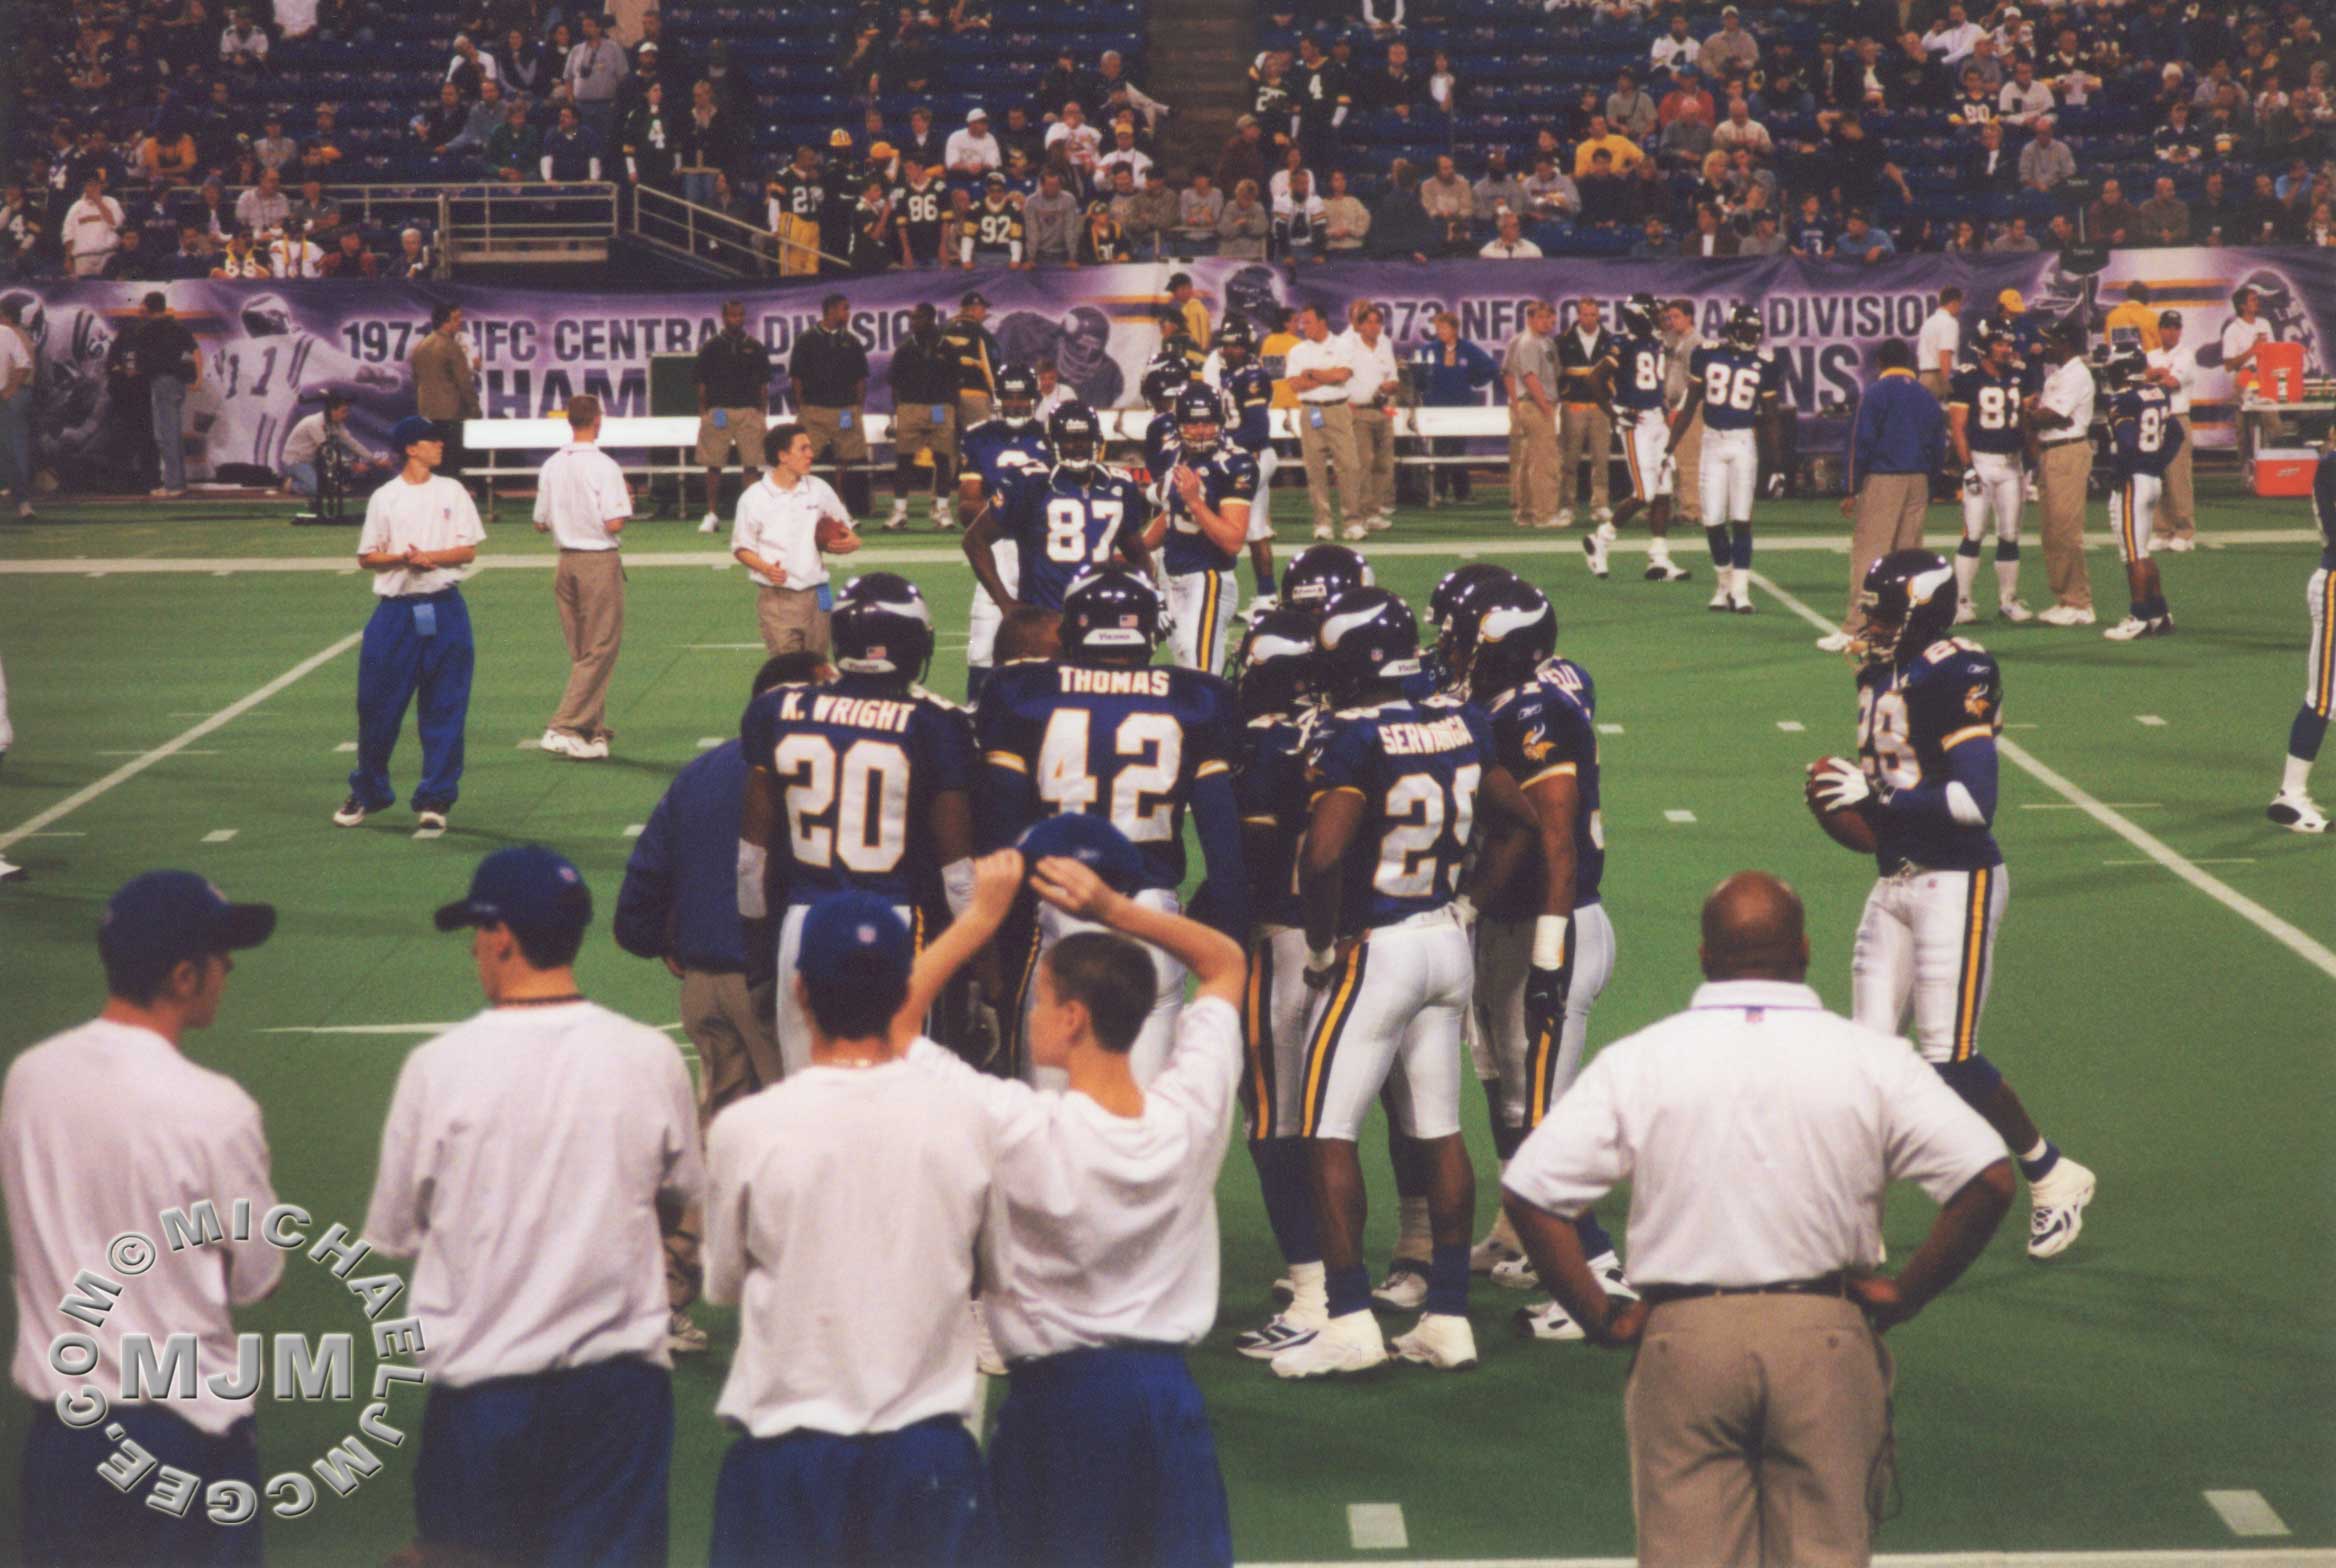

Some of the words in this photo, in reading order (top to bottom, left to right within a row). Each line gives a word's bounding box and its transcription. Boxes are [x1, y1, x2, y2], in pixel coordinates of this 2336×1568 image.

[1309, 74, 1324, 99] 4
[648, 119, 665, 149] 4
[908, 195, 938, 222] 86
[980, 215, 1011, 243] 92
[342, 320, 434, 362] 197
[1704, 362, 1761, 410] 86
[1046, 498, 1124, 563] 87
[1058, 665, 1170, 697] THOMAS
[780, 694, 806, 721] K.
[813, 696, 916, 733] WRIGHT
[1037, 708, 1184, 842] 42
[774, 733, 911, 873] 20
